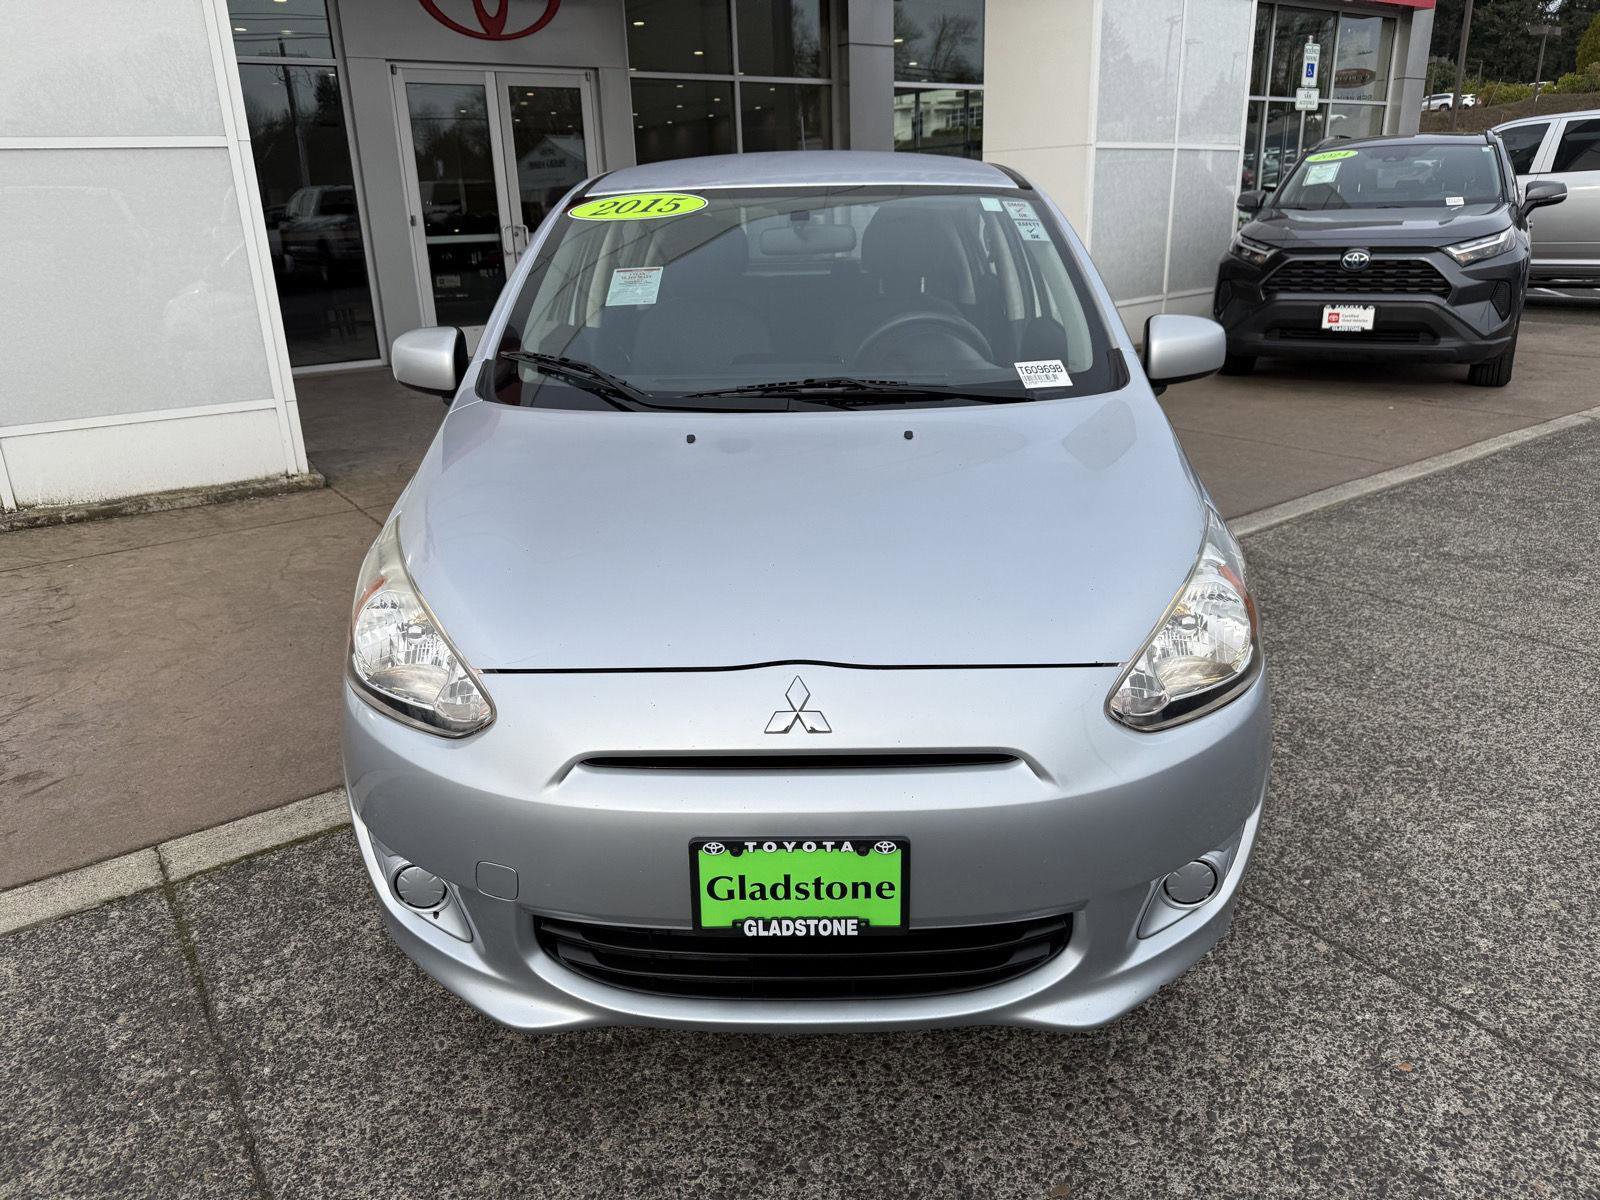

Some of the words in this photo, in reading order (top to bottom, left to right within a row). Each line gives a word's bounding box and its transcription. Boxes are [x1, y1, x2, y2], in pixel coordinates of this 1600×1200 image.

[588, 197, 689, 217] 2015
[1017, 364, 1063, 375] T60969B
[744, 841, 855, 853] TOYOTA
[706, 874, 896, 901] Gladstone
[743, 919, 859, 937] GLADSTONE
